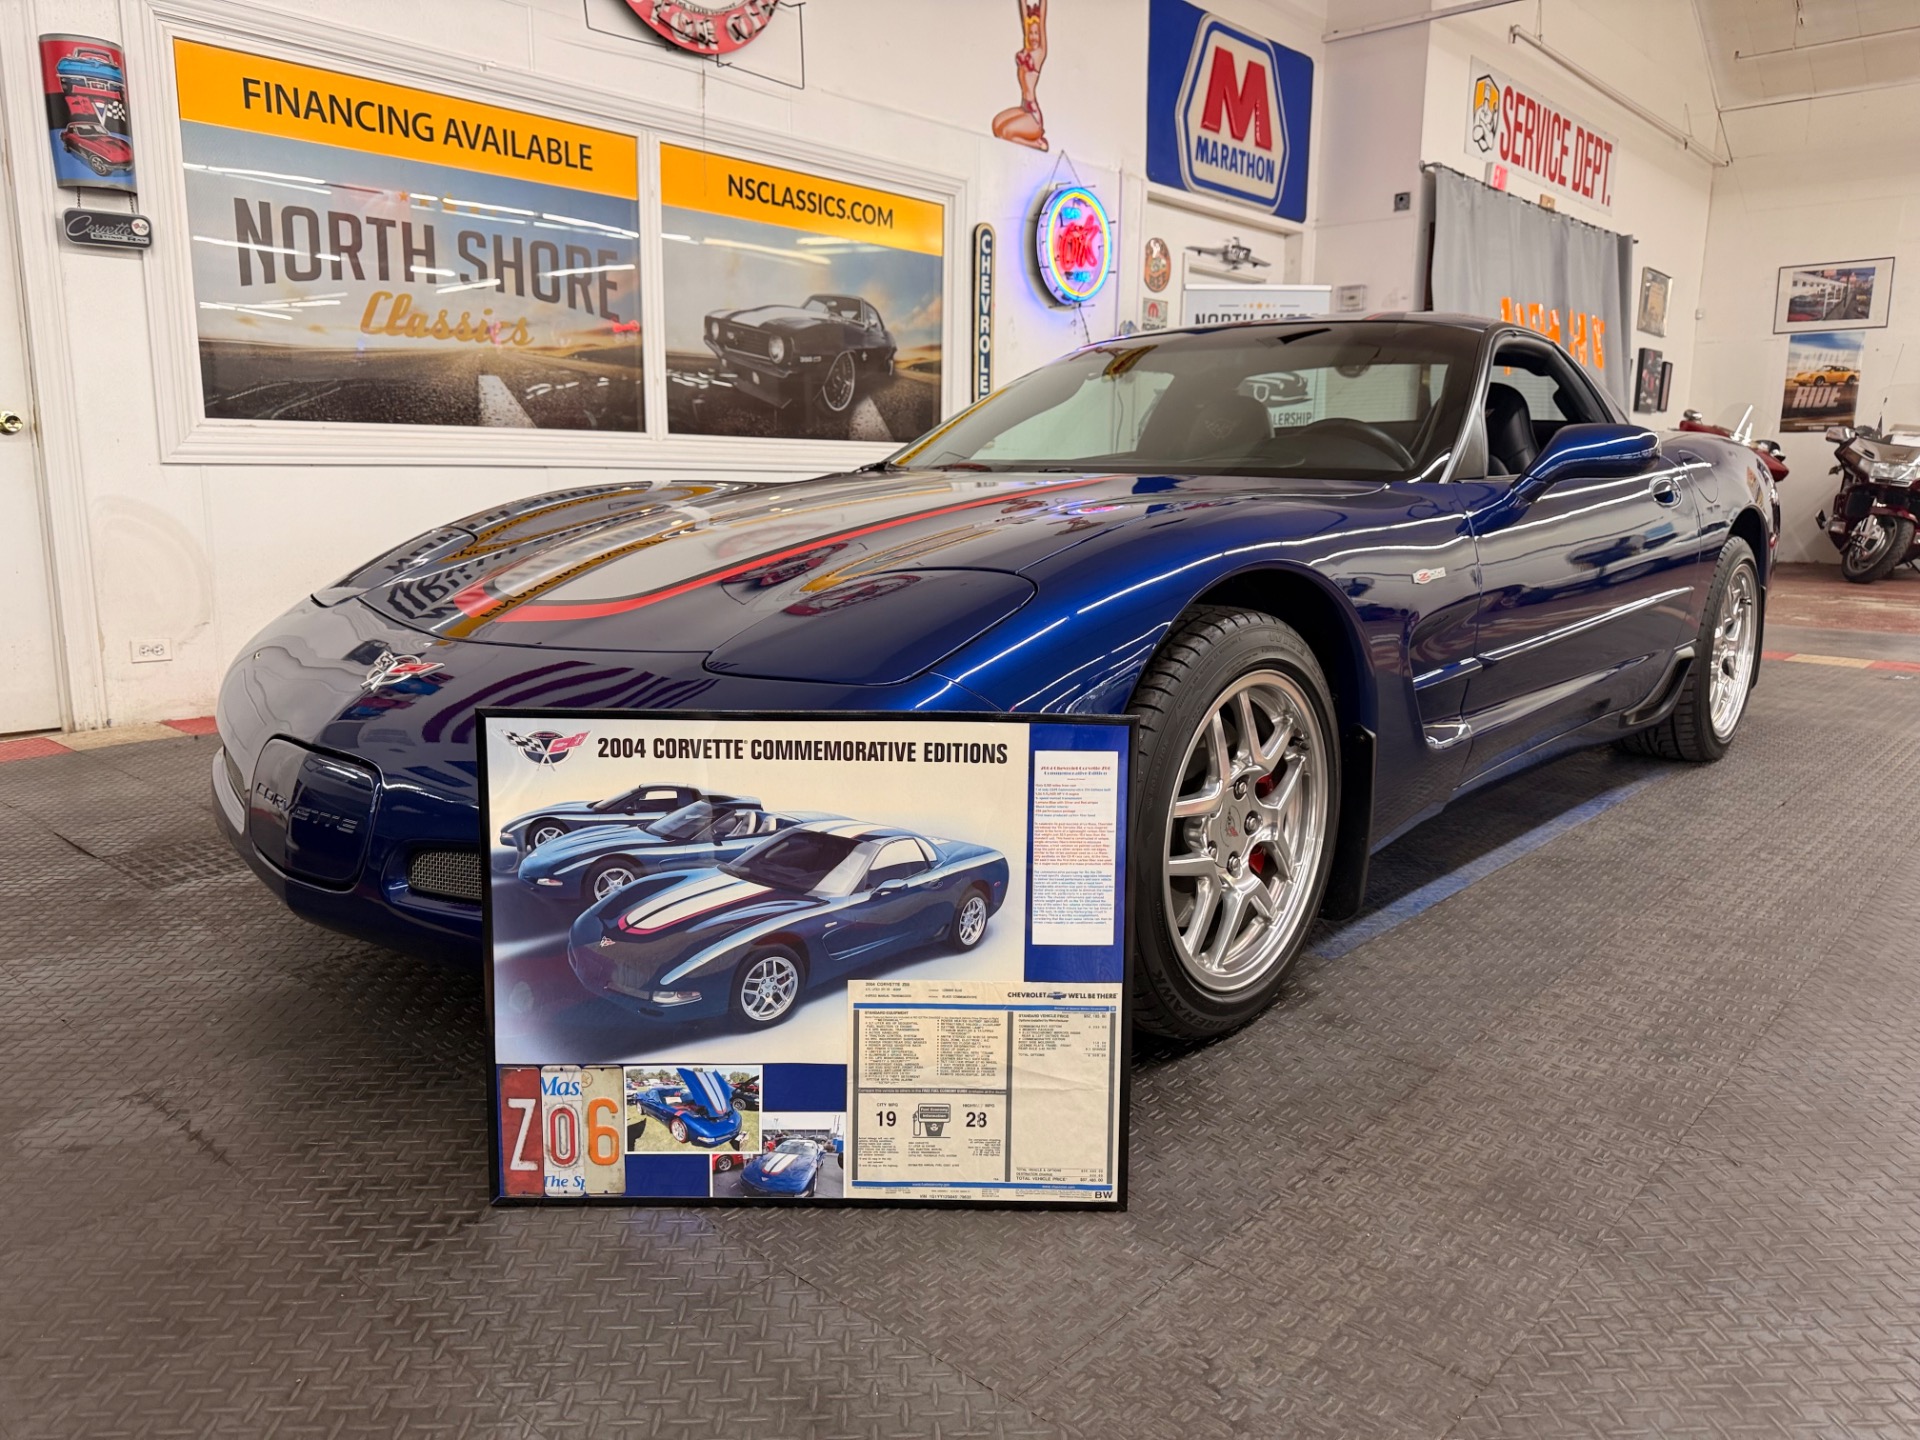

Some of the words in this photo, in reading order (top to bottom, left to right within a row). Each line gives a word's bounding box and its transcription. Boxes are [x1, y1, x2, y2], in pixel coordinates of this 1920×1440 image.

[241, 77, 437, 143] FINANCING
[442, 116, 595, 172] AVAILABLE
[1499, 85, 1571, 187] SERVICE
[1572, 125, 1613, 207] DEPT.
[1195, 135, 1275, 184] MARATHON
[727, 173, 894, 229] NSCLASSICS.COM
[67, 215, 133, 236] Corvette
[233, 197, 438, 287] NORTH
[456, 229, 621, 323] SHORE
[359, 290, 535, 347] Classics
[1792, 386, 1841, 409] RIDE
[1273, 412, 1312, 426] LERSHIP
[597, 737, 647, 759] 2004
[653, 738, 744, 760] CORVETTE
[750, 739, 917, 762] COMMEMORATIVE
[923, 742, 1008, 764] EDITIONS
[256, 782, 359, 835] CORVETTE
[1007, 991, 1047, 999] CHEVROLET
[541, 1076, 583, 1096] Mas
[876, 1110, 897, 1127] 19
[965, 1111, 987, 1128] 28
[1094, 1191, 1114, 1199] BW
